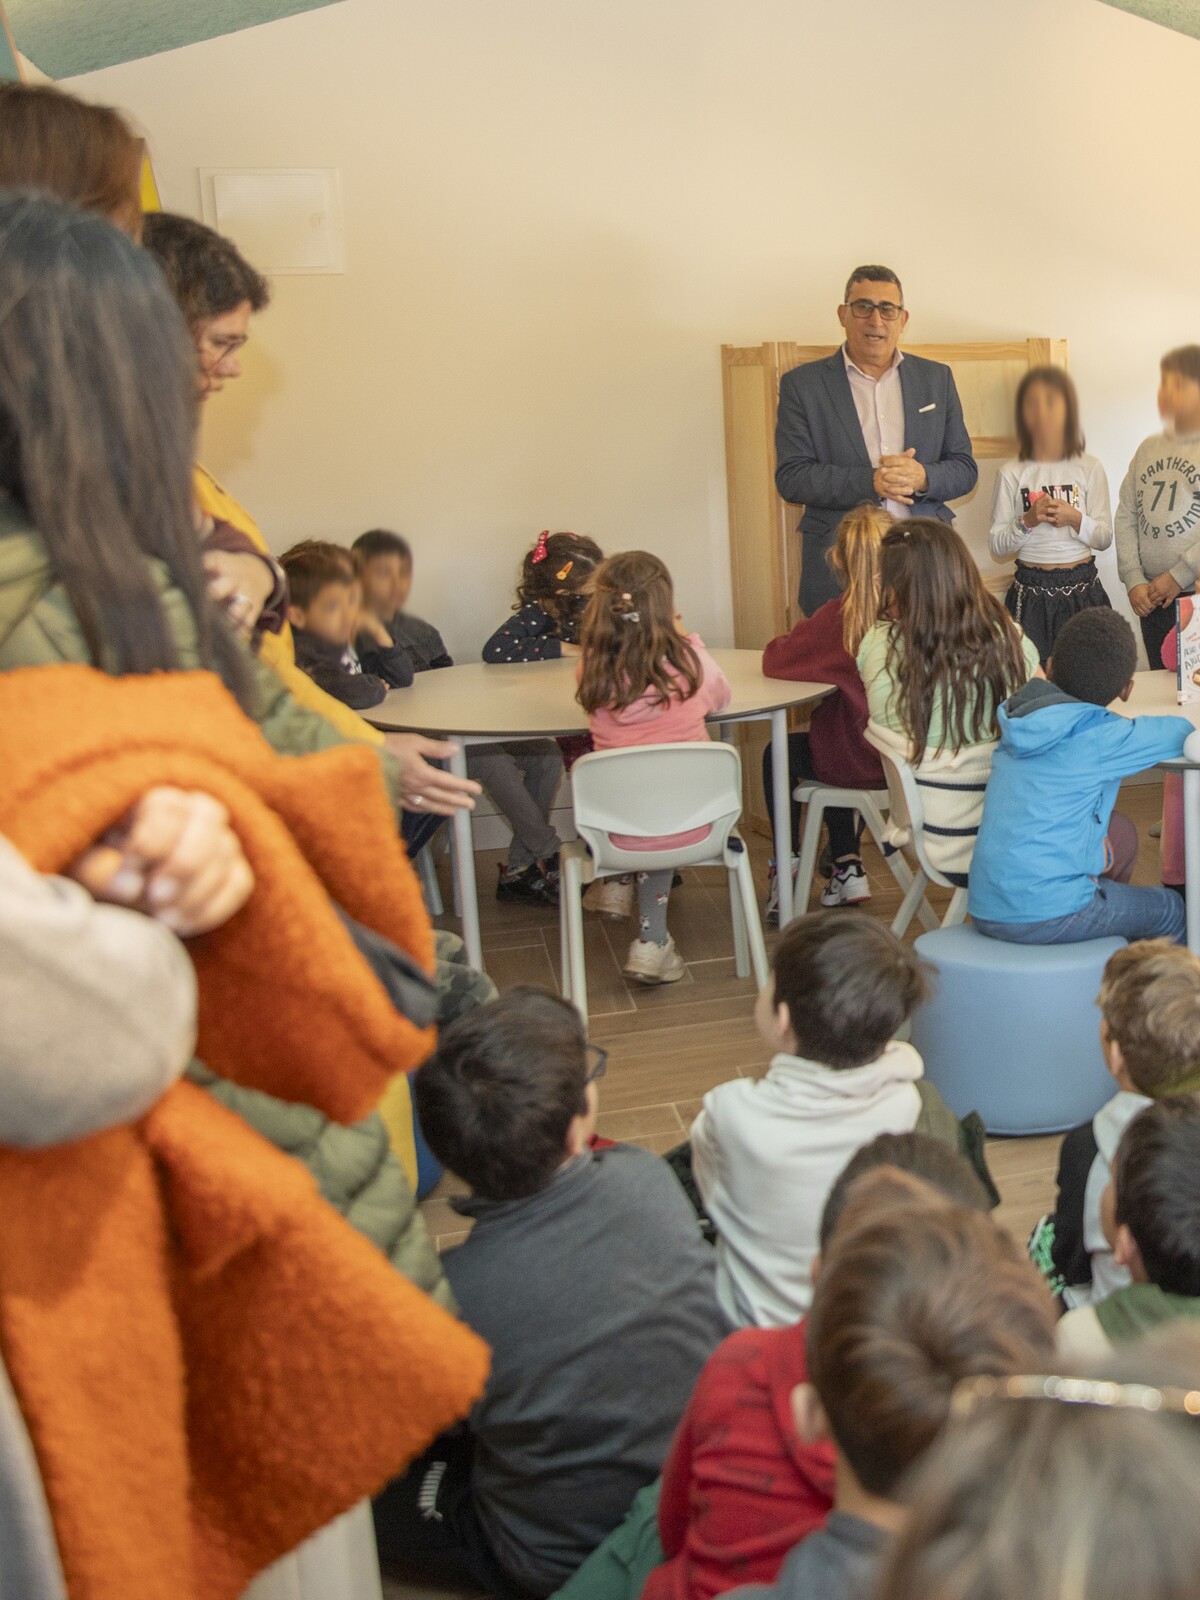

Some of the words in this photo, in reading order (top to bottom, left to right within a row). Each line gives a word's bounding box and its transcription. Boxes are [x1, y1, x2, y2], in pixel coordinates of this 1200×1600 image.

[1150, 480, 1178, 512] 71
[1137, 489, 1150, 536] TIGERS
[1151, 526, 1160, 540] &
